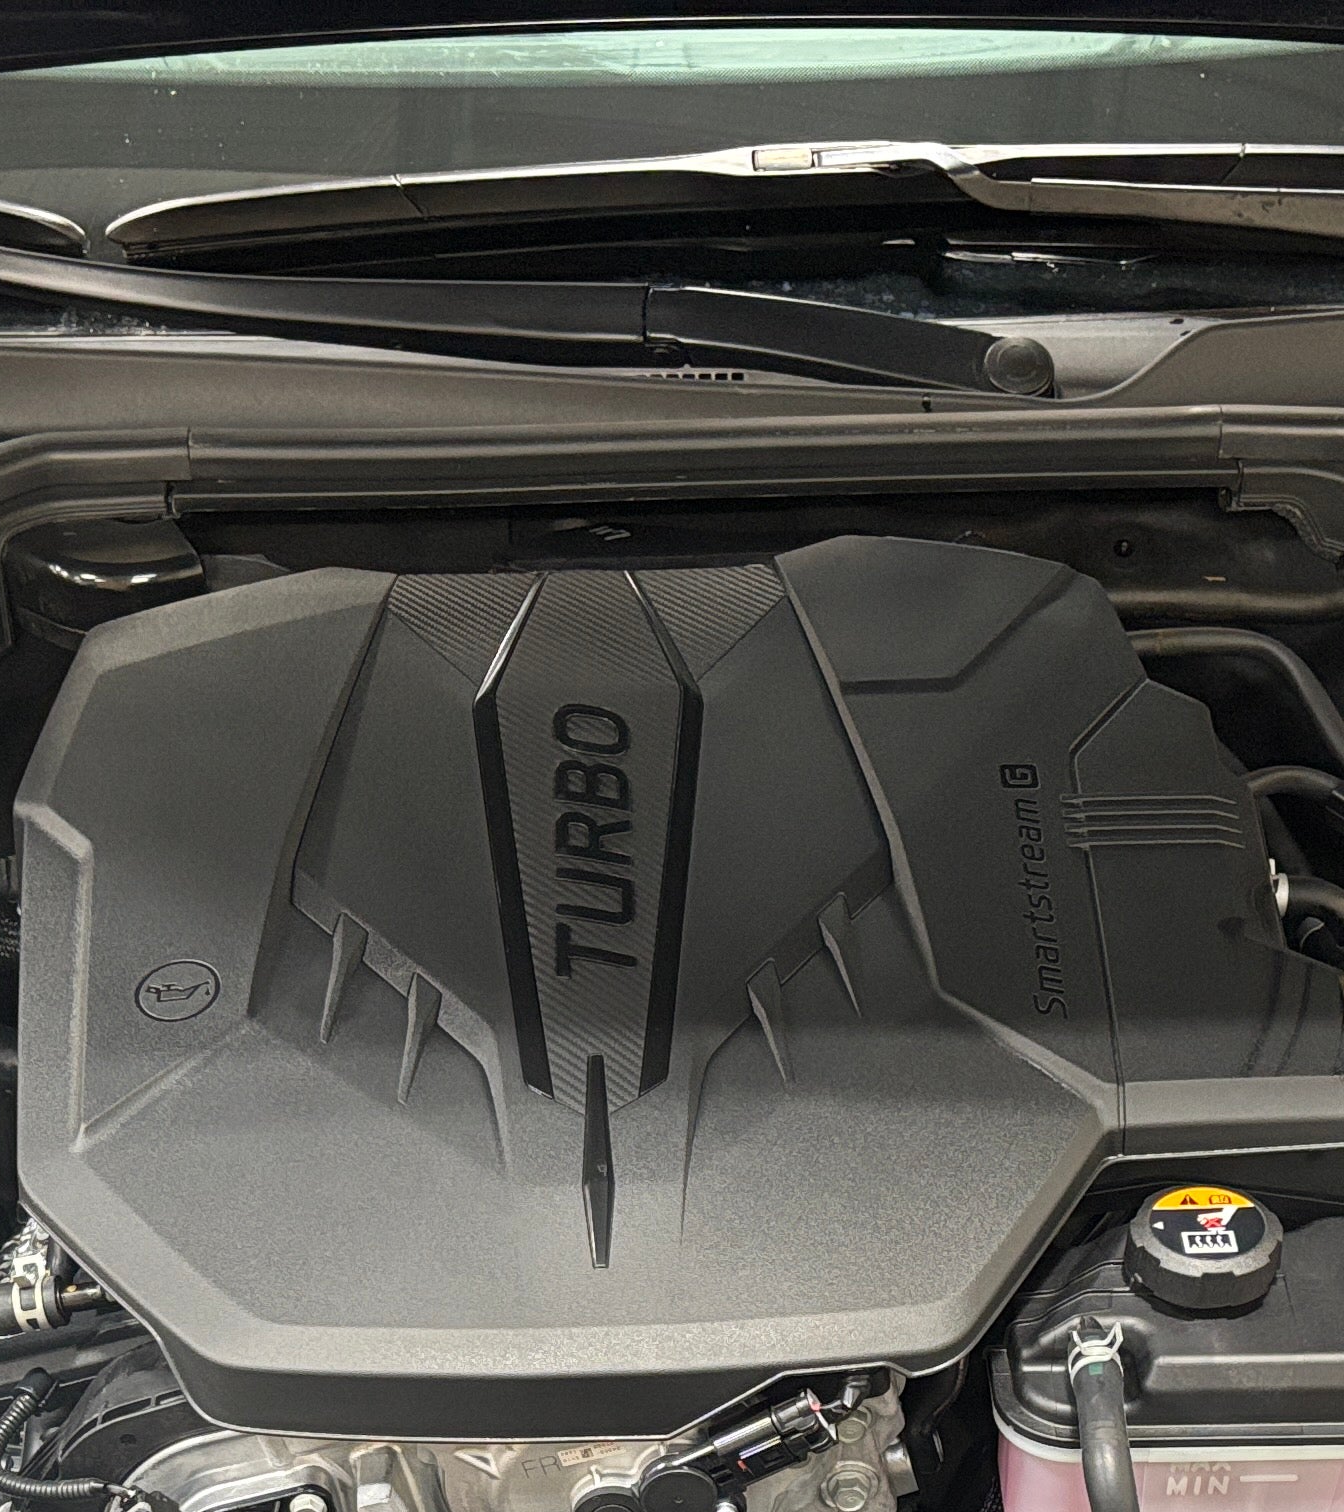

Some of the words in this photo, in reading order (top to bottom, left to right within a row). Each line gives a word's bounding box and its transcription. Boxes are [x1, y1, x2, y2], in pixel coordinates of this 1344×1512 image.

[553, 704, 637, 979] TURBO
[1014, 798, 1068, 1020] Smartstream
[1166, 1475, 1230, 1496] MIN
